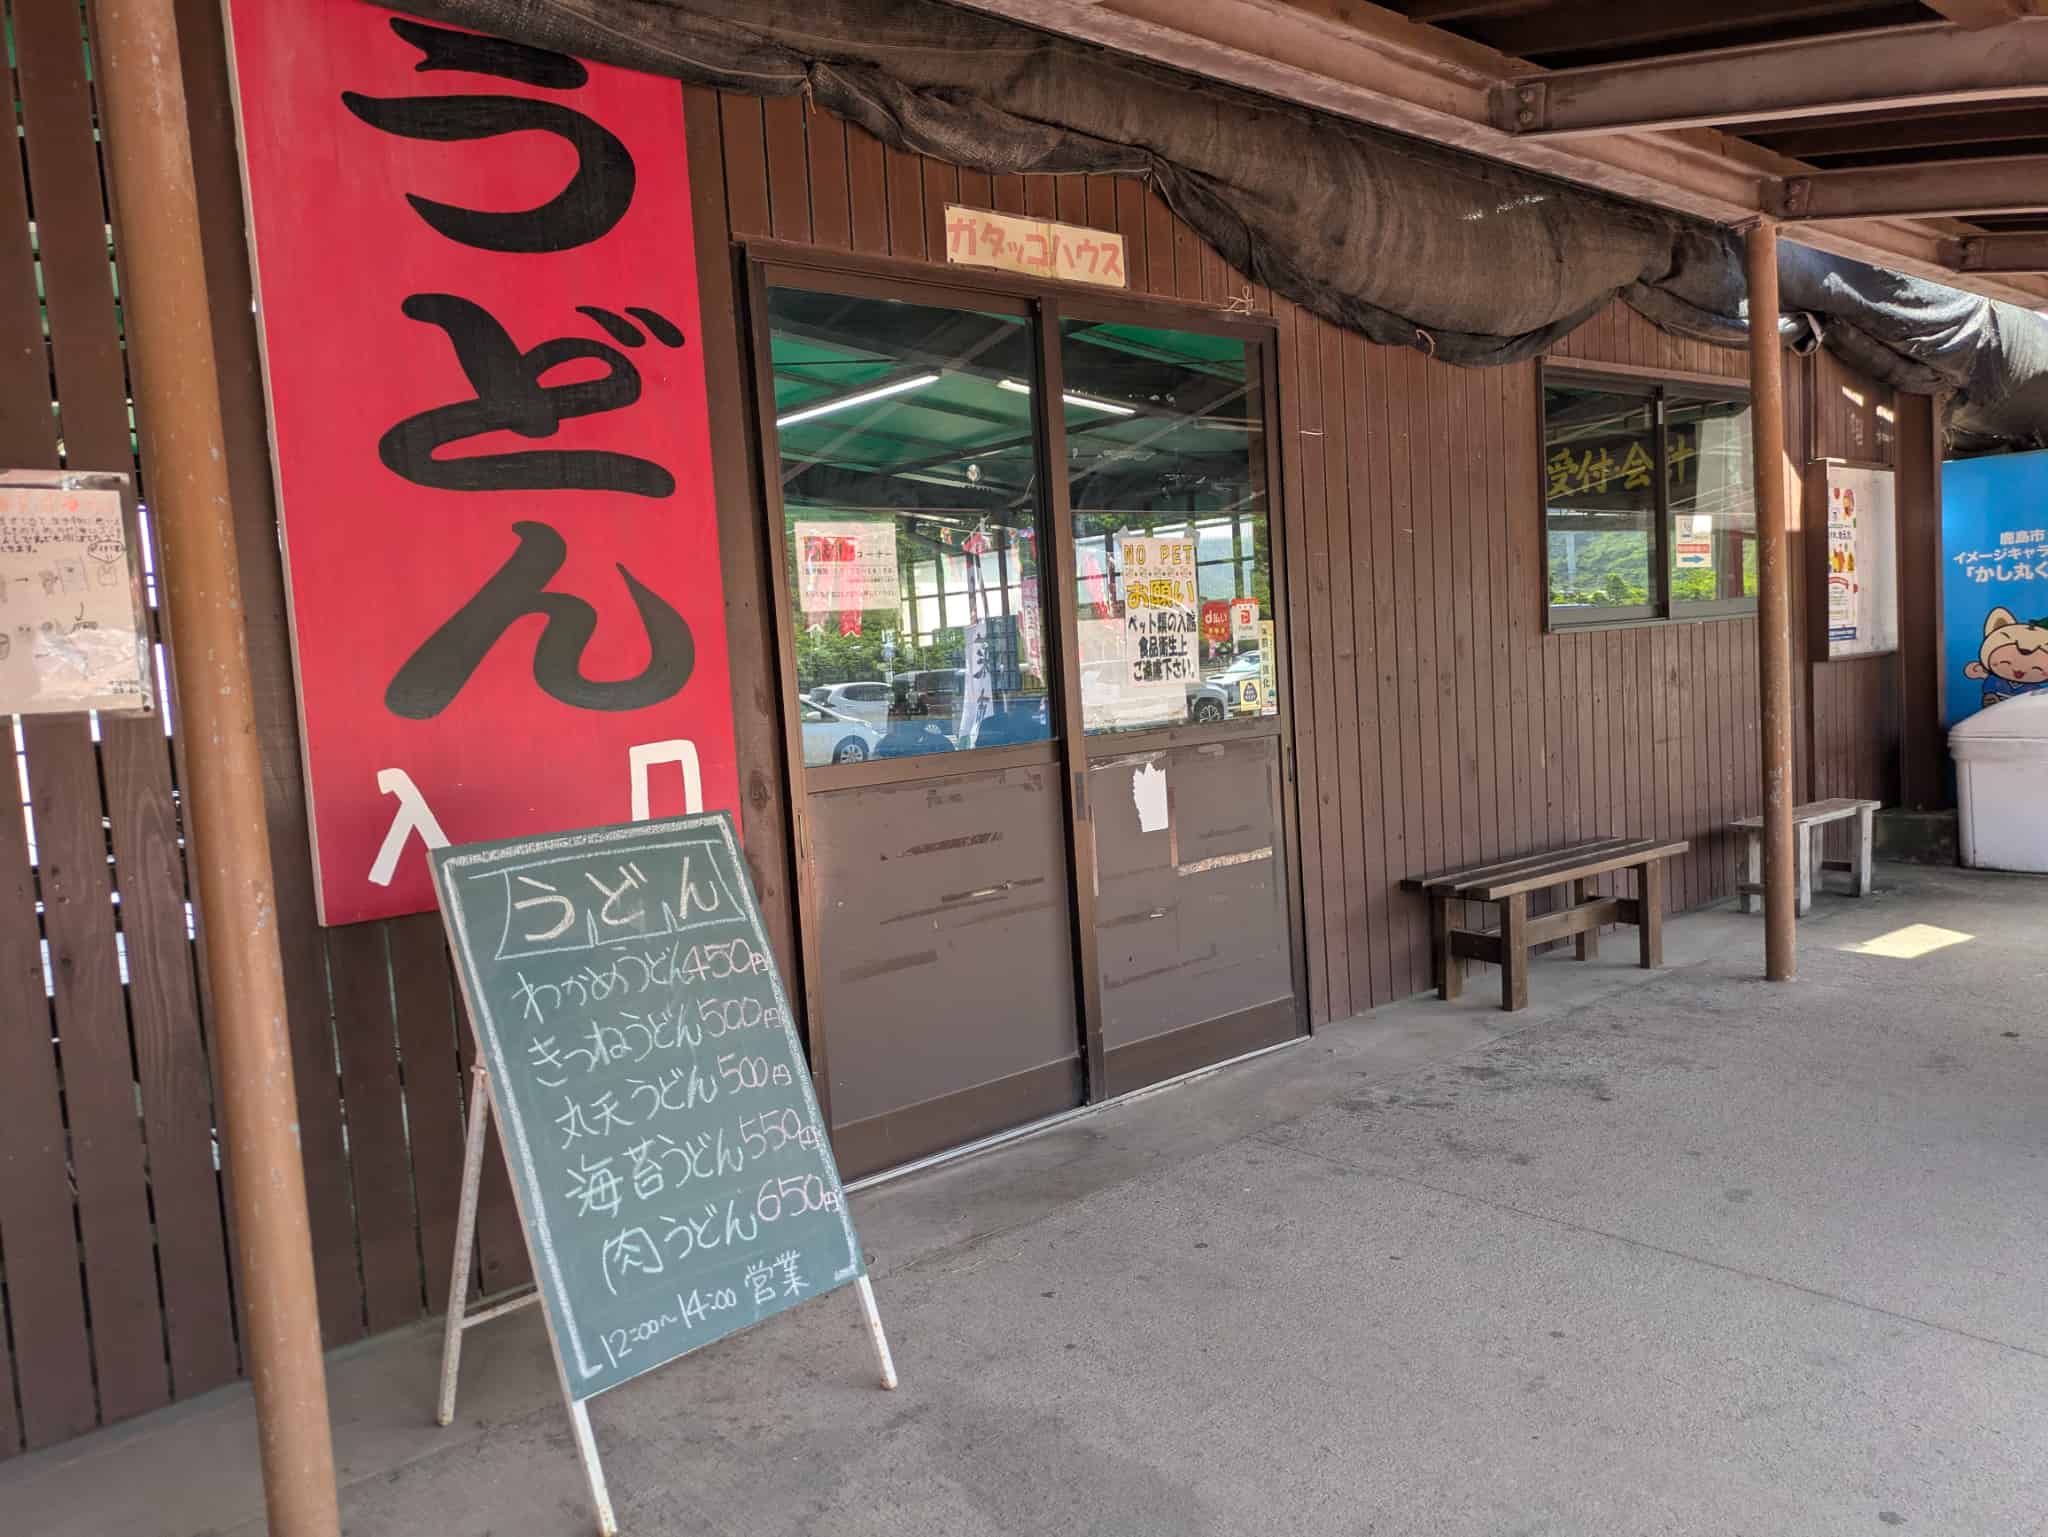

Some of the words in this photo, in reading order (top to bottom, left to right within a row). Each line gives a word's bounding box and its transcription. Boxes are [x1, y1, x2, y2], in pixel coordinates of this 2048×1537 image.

[947, 217, 1123, 279] ガタッコハウス
[341, 17, 696, 720] うどん
[1123, 543, 1147, 566] NO
[1159, 543, 1193, 566] PET
[1126, 579, 1195, 610] お願い
[367, 738, 704, 887] 入口
[513, 855, 720, 942] うどん
